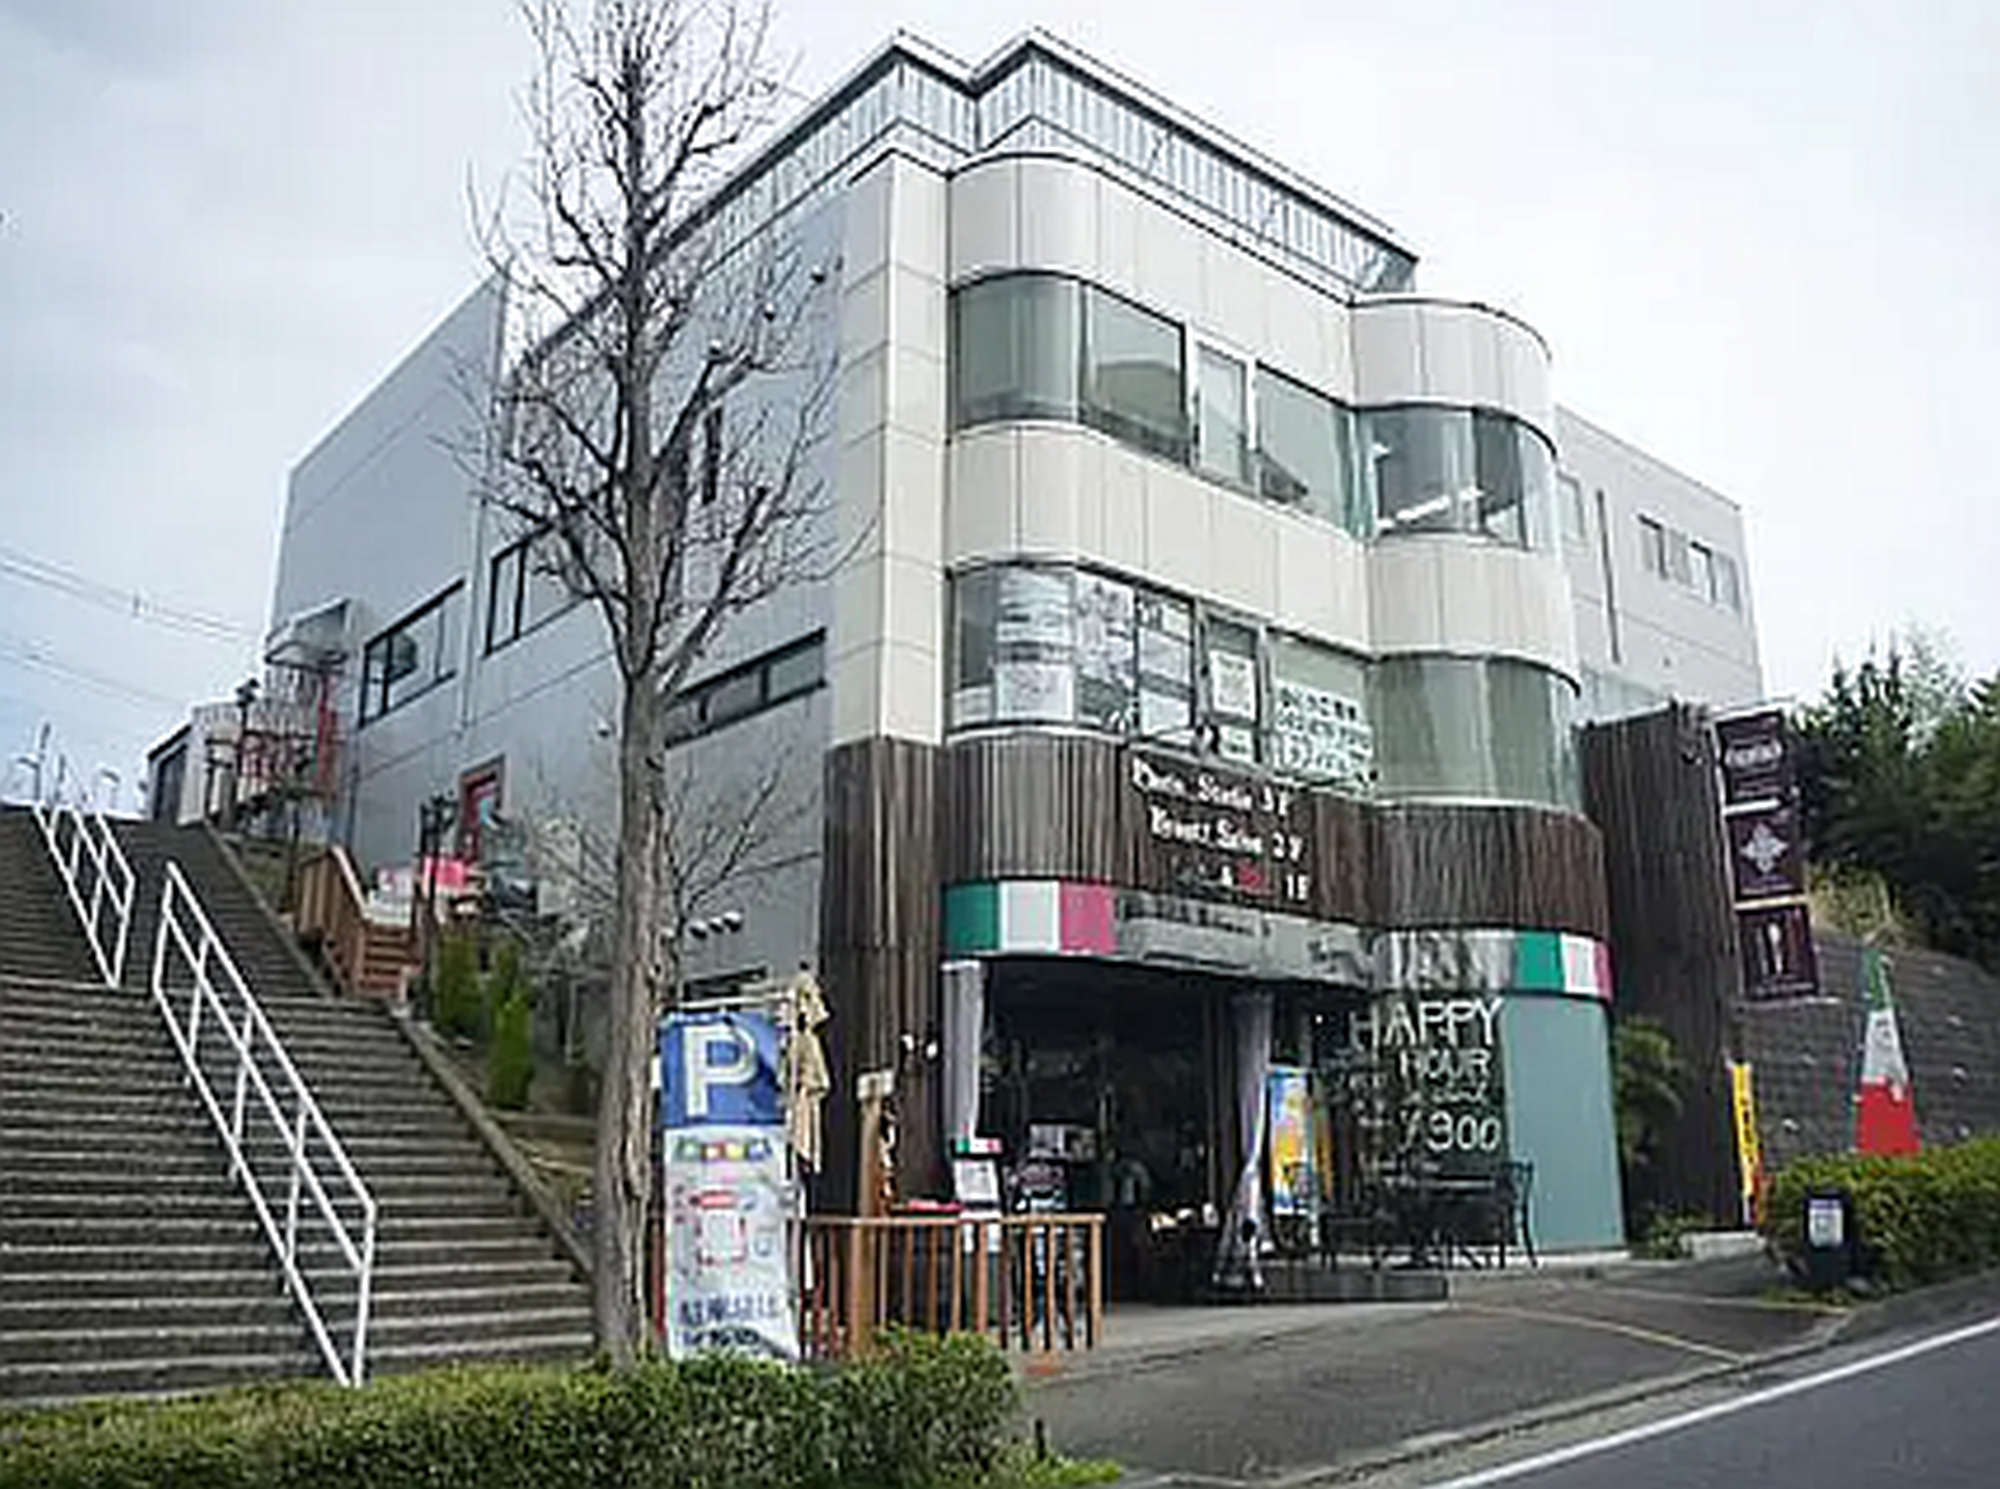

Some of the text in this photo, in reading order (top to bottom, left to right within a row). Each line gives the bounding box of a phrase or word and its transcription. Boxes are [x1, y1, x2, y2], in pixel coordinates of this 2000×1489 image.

[1349, 997, 1502, 1051] HAPPY
[683, 1021, 756, 1117] P
[1401, 1049, 1491, 1080] HOUR
